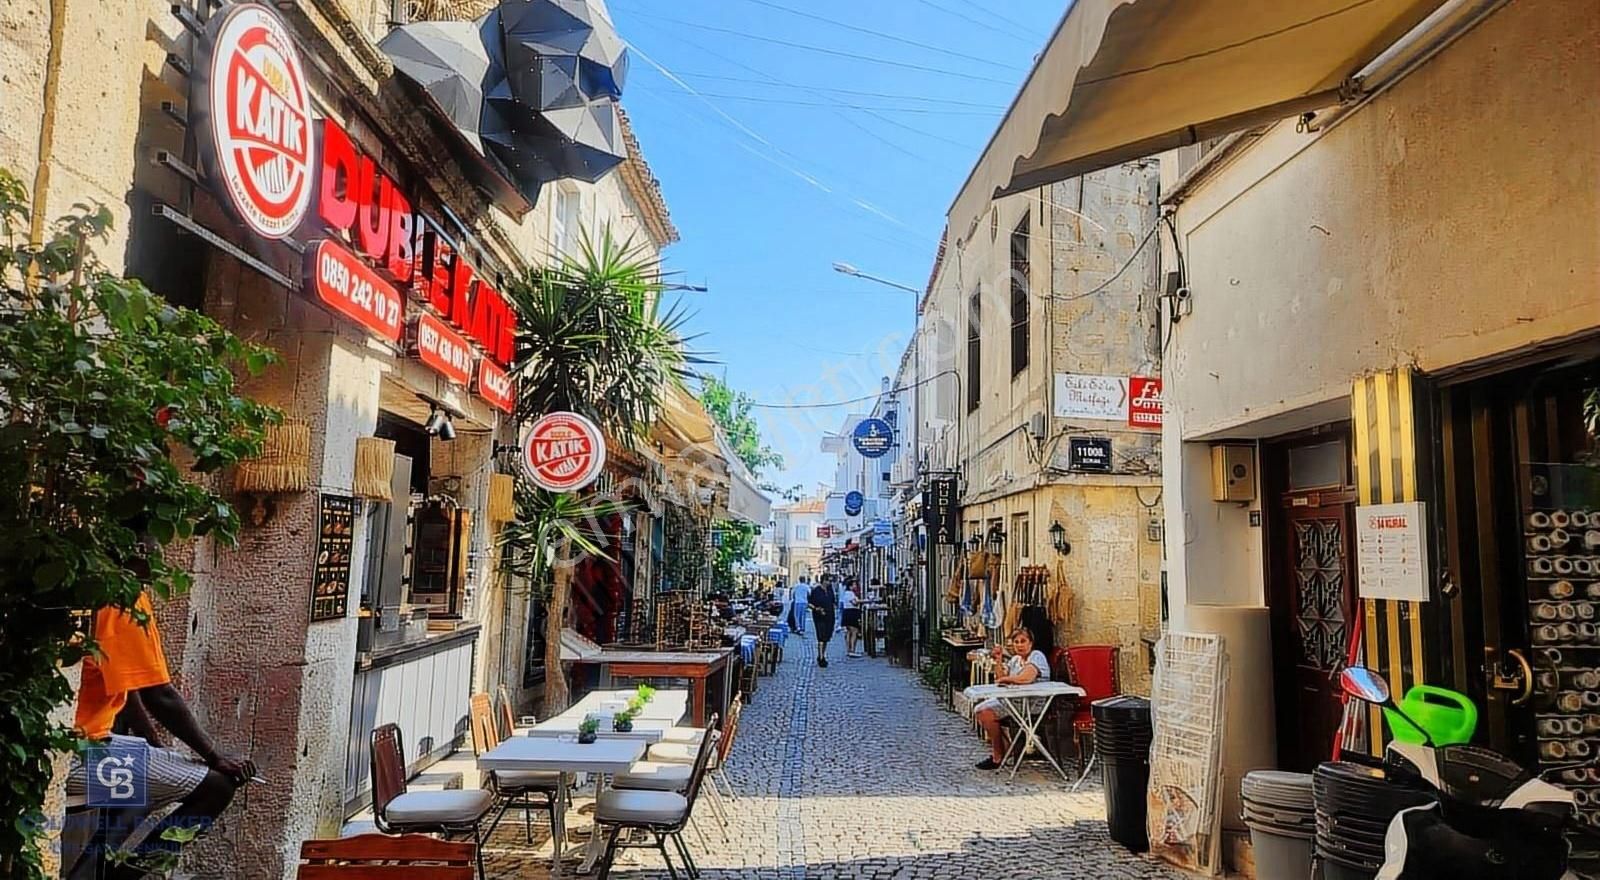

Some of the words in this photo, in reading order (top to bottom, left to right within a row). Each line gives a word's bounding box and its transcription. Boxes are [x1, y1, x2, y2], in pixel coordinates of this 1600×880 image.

[236, 65, 304, 152] KATIK
[322, 252, 349, 297] 0850
[351, 273, 373, 312] 242
[375, 289, 386, 320] 10
[387, 298, 399, 328] 27
[536, 438, 586, 463] KATIK
